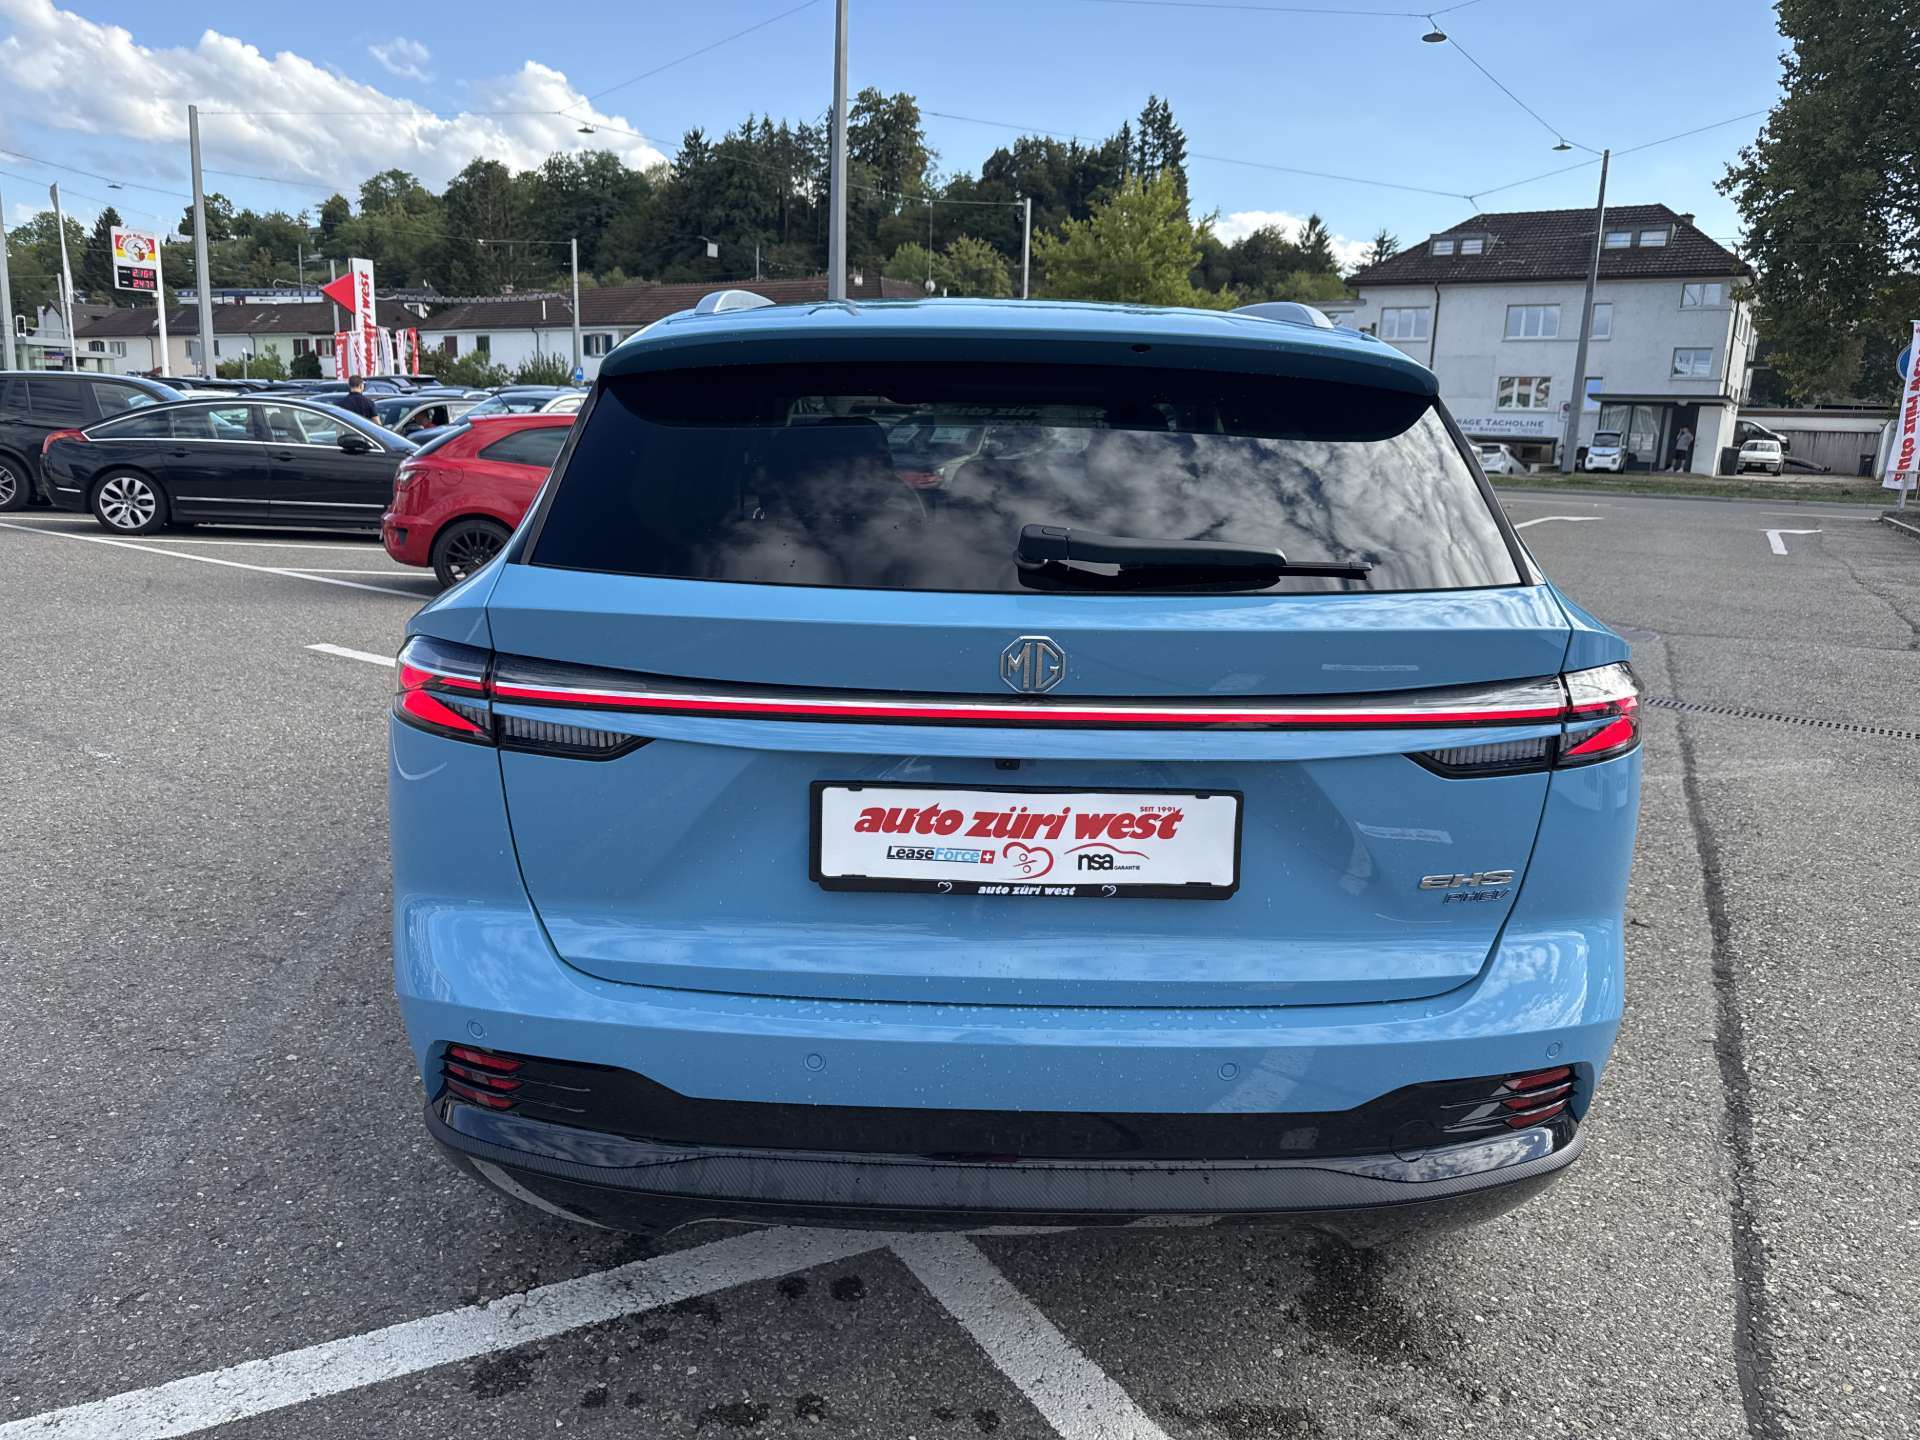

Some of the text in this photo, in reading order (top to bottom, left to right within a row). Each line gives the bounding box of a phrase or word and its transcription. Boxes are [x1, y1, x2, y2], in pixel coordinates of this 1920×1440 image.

[359, 271, 370, 309] west
[1485, 418, 1544, 428] TACHOLINE
[1007, 642, 1060, 689] MG
[854, 802, 1184, 840] auto züri west
[886, 845, 981, 863] LeaseForce
[1077, 853, 1114, 871] nsa
[1420, 869, 1516, 889] EHS
[977, 884, 1076, 896] auto züri west
[1442, 887, 1512, 904] PHEV
